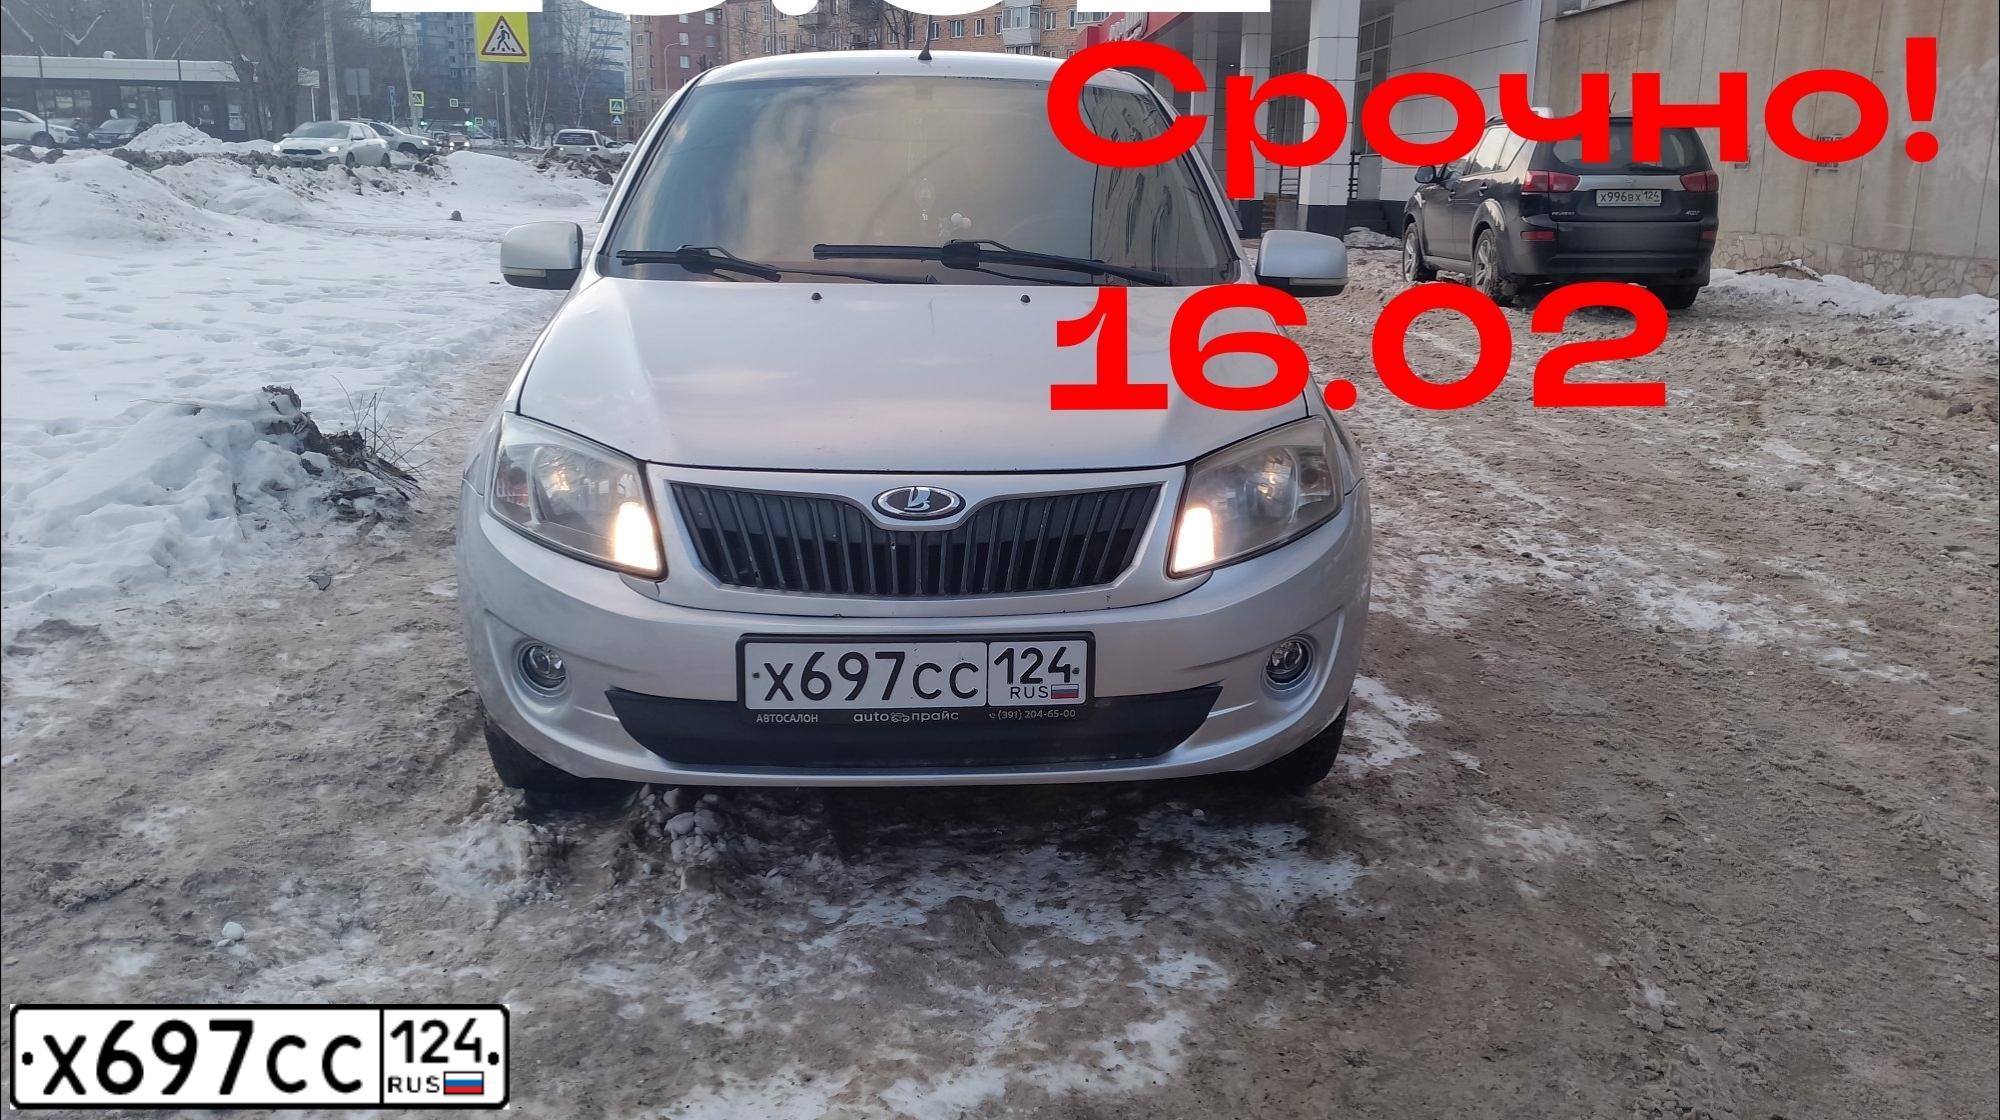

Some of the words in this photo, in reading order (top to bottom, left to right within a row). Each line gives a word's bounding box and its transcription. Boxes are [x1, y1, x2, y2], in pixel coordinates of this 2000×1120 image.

[993, 646, 1072, 685] 124
[1009, 684, 1050, 700] RUS
[755, 712, 819, 724] АВТОСАЛОН
[1024, 708, 1076, 720] 204-65-00
